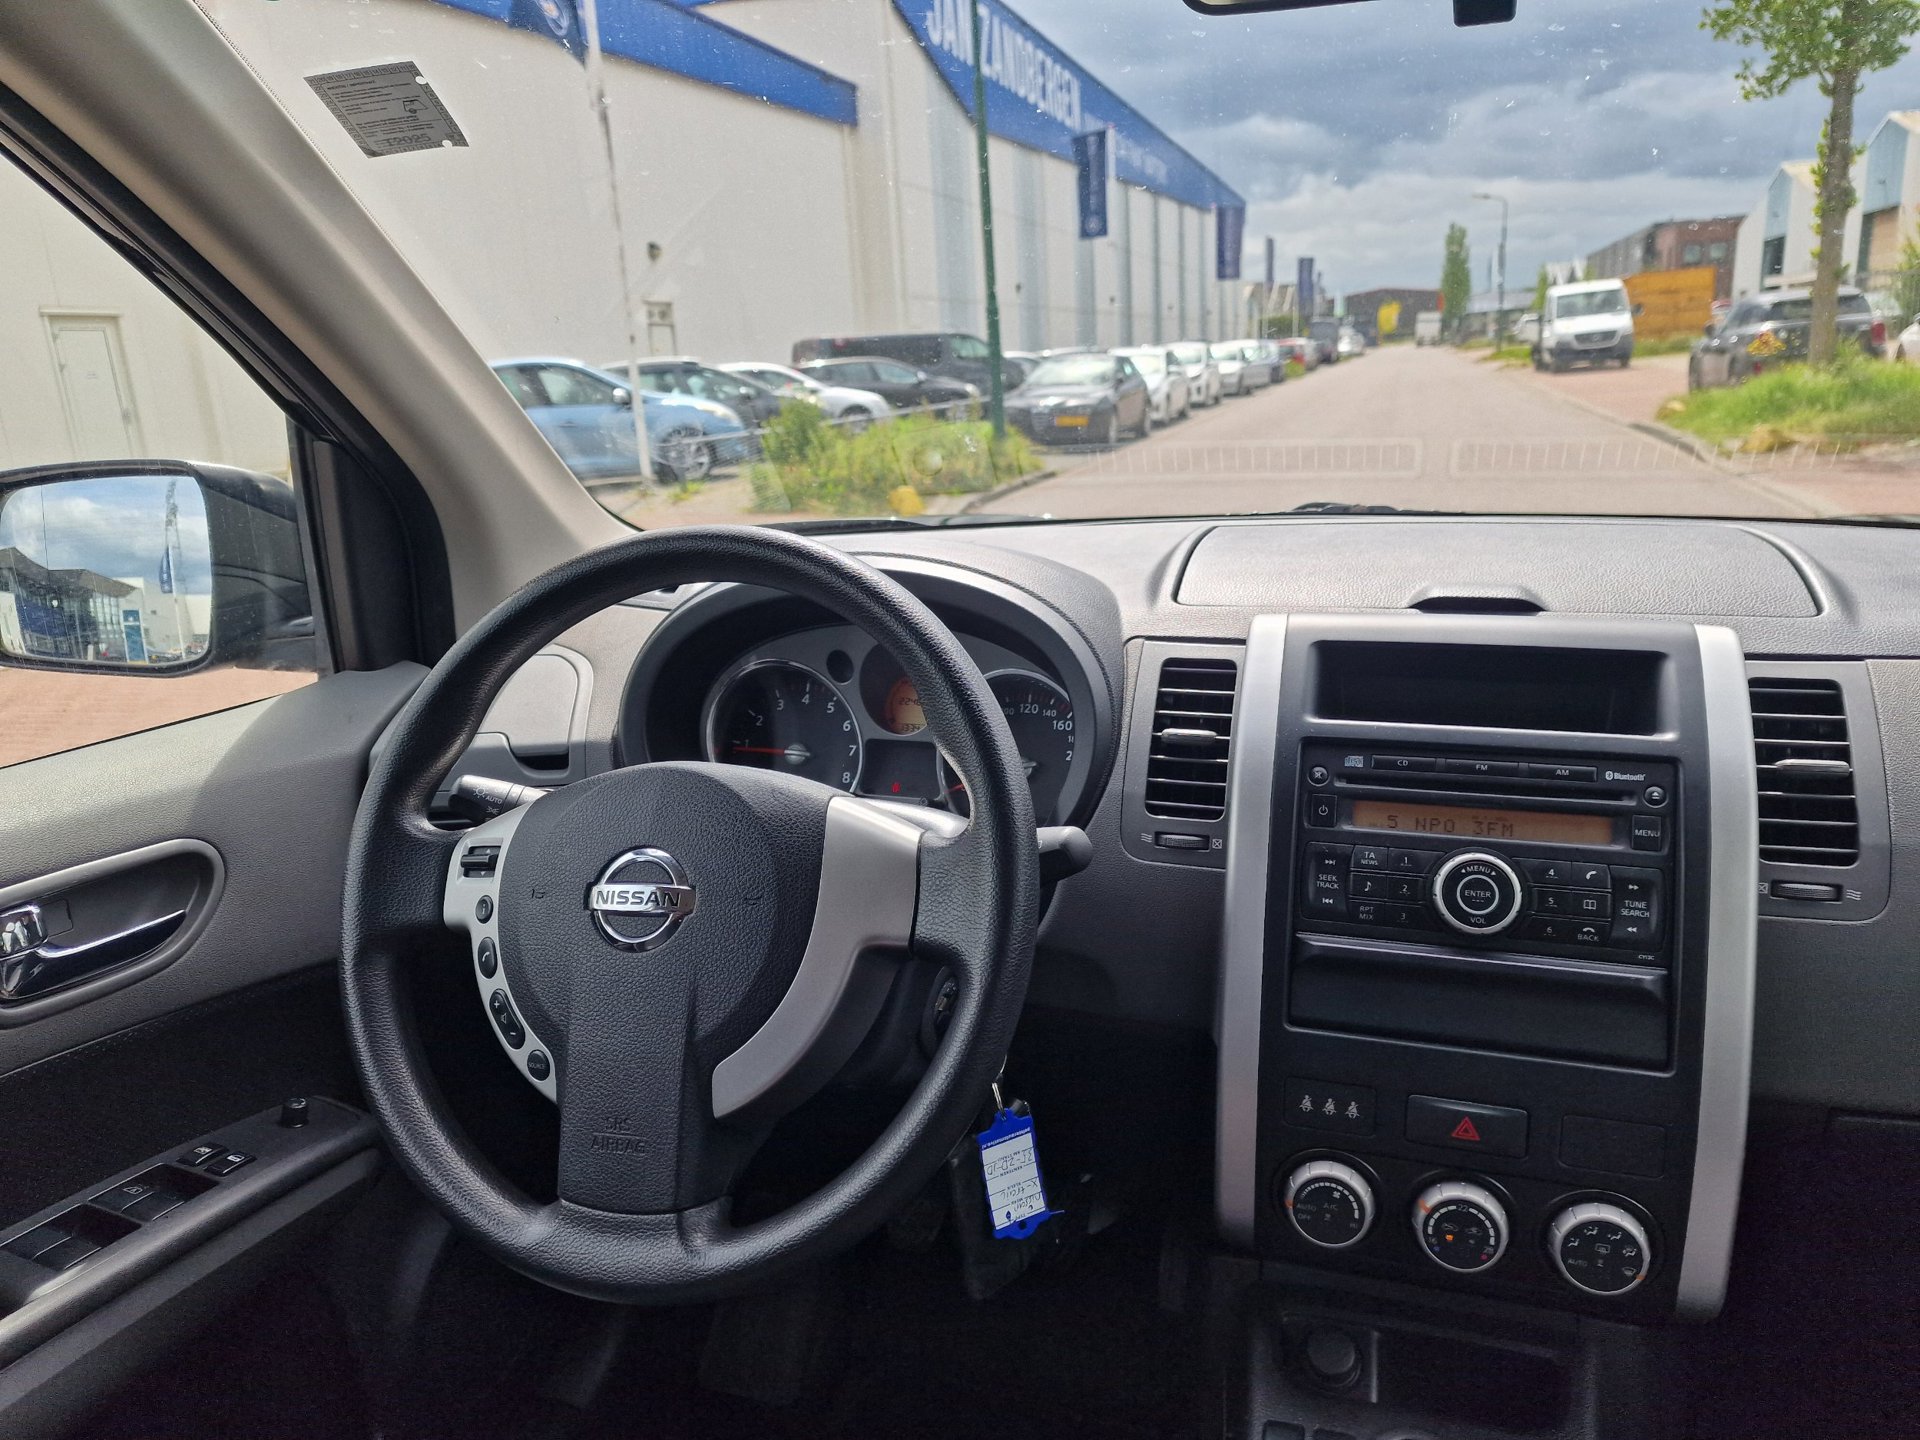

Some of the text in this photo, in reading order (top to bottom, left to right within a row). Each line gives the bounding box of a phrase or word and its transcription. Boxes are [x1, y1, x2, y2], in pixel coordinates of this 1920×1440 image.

[802, 694, 810, 704] 4
[776, 700, 784, 710] 3
[826, 702, 835, 714] 5
[1019, 703, 1040, 714] 120
[1042, 708, 1057, 718] 140
[755, 716, 764, 727] 2
[842, 720, 851, 732] 6
[1052, 720, 1073, 731] 160
[848, 744, 857, 756] 7
[1397, 759, 1409, 767] CD
[1476, 764, 1488, 772] FM
[1556, 768, 1570, 776] AM
[842, 772, 850, 784] 8
[1416, 817, 1455, 834] NPO
[1473, 820, 1514, 838] 3FM
[1634, 828, 1660, 838] MENU
[1466, 865, 1492, 874] MENU
[1318, 874, 1338, 882] SEEK
[1316, 882, 1339, 890] TRACK
[595, 889, 681, 908] NISSAN
[1464, 889, 1492, 898] ENTER
[1624, 900, 1648, 909] TUNE
[1359, 913, 1374, 921] MIX
[1620, 908, 1650, 918] SEARCH
[1577, 934, 1600, 942] BACK
[591, 1136, 645, 1154] AIRBAG
